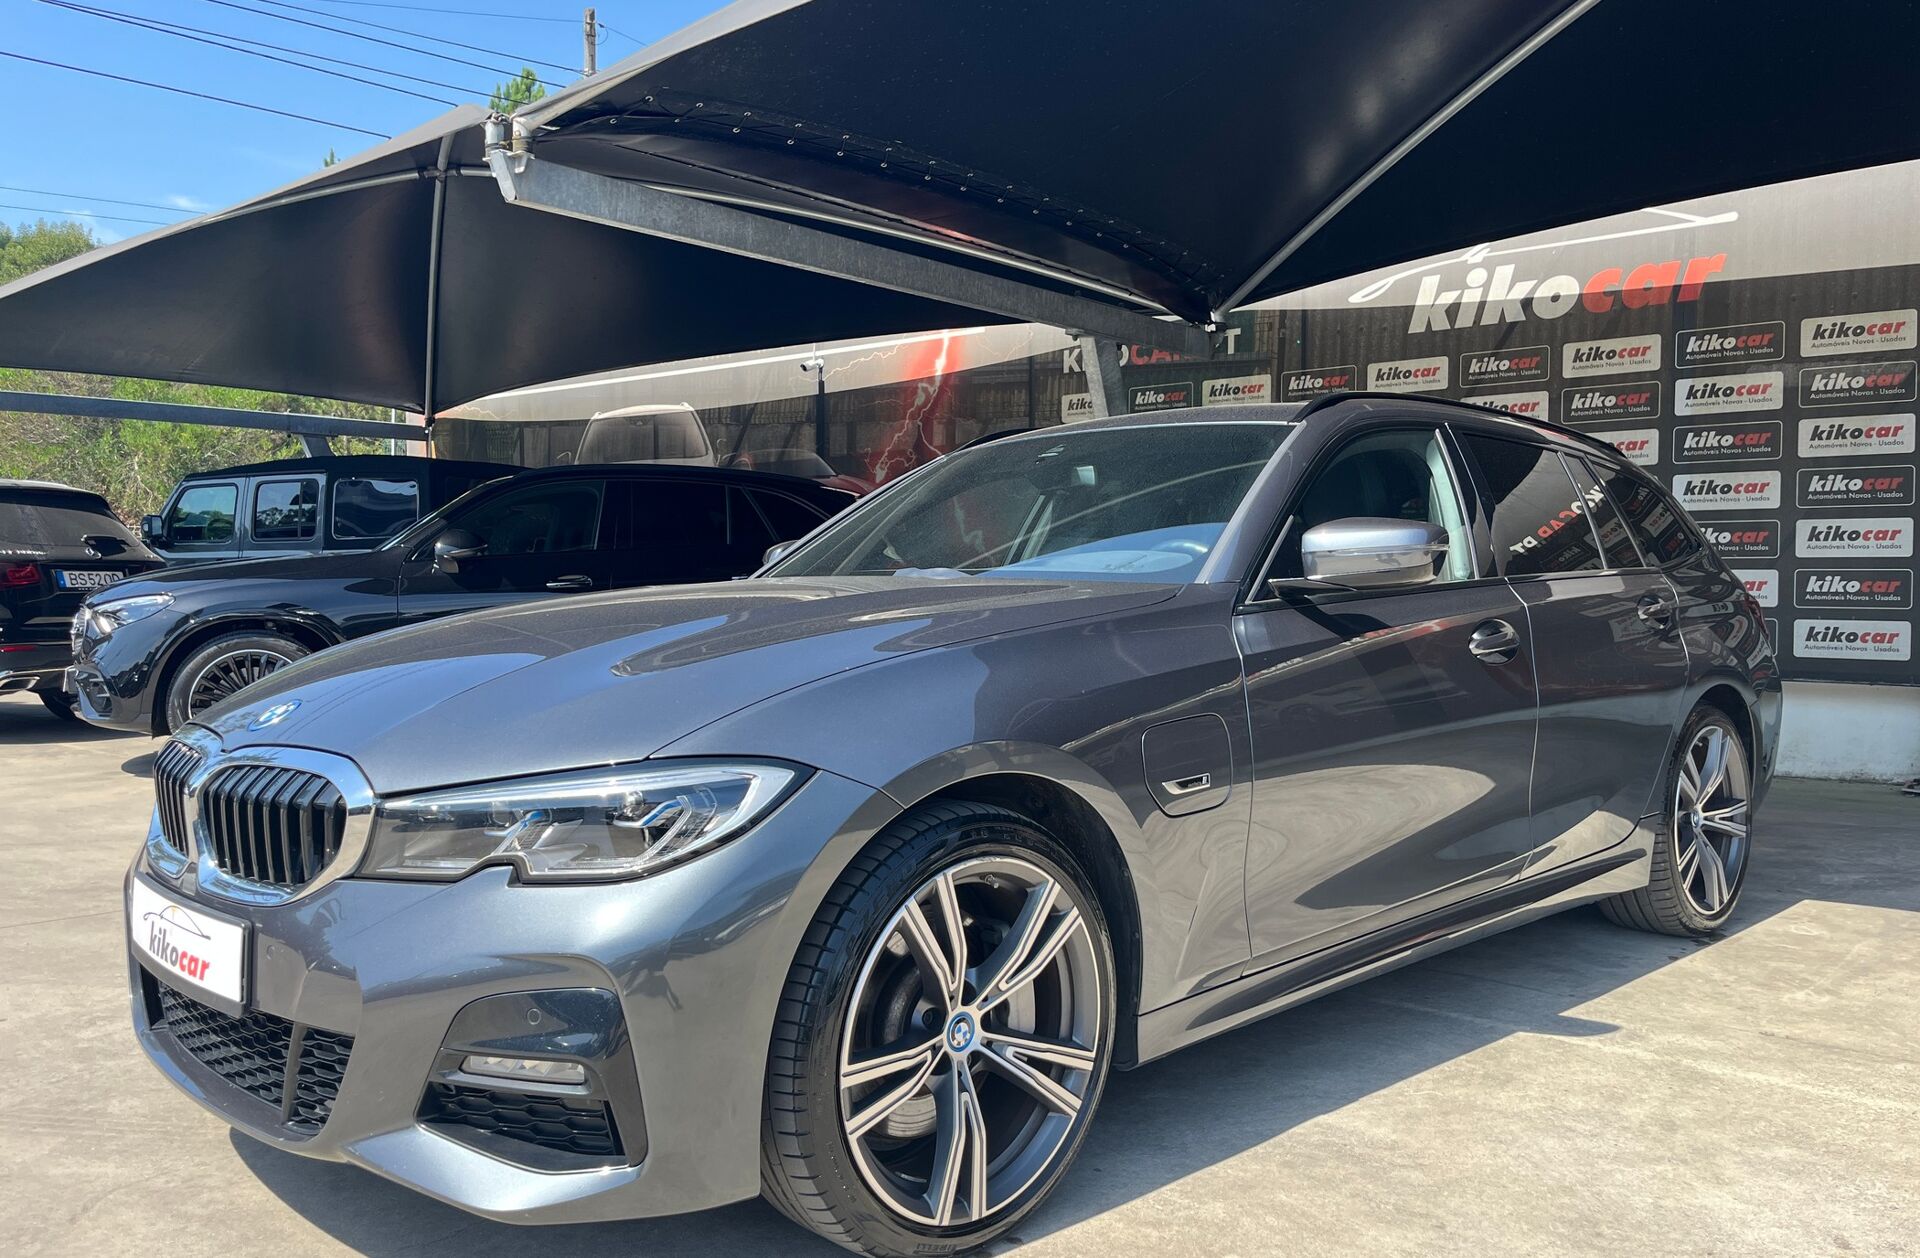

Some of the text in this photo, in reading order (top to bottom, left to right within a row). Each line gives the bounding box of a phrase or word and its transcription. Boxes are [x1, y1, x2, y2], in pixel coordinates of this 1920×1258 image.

[1408, 253, 1728, 334] kikocar
[1812, 322, 1906, 341] kikocar
[1686, 333, 1775, 353] kikocar
[1572, 346, 1651, 363] kikocar
[1375, 365, 1440, 382] kikocar
[1468, 356, 1540, 374] kikocar
[1209, 382, 1264, 398] kikocar
[1288, 374, 1349, 391] kikocar
[1810, 372, 1905, 392] kikocar
[1135, 390, 1186, 405] kikocar
[1571, 392, 1650, 410] kikocar
[1686, 383, 1773, 401] kikocar
[1067, 398, 1093, 411] kiko
[1684, 431, 1772, 449] kikocar
[1810, 424, 1904, 441] kikocar
[1683, 480, 1770, 496] kikocar
[1808, 475, 1904, 492] kikocar
[1808, 526, 1902, 542] kikocar
[1806, 575, 1902, 593] kikocar
[1805, 626, 1900, 644] kikocar
[149, 921, 210, 981] kikocar
